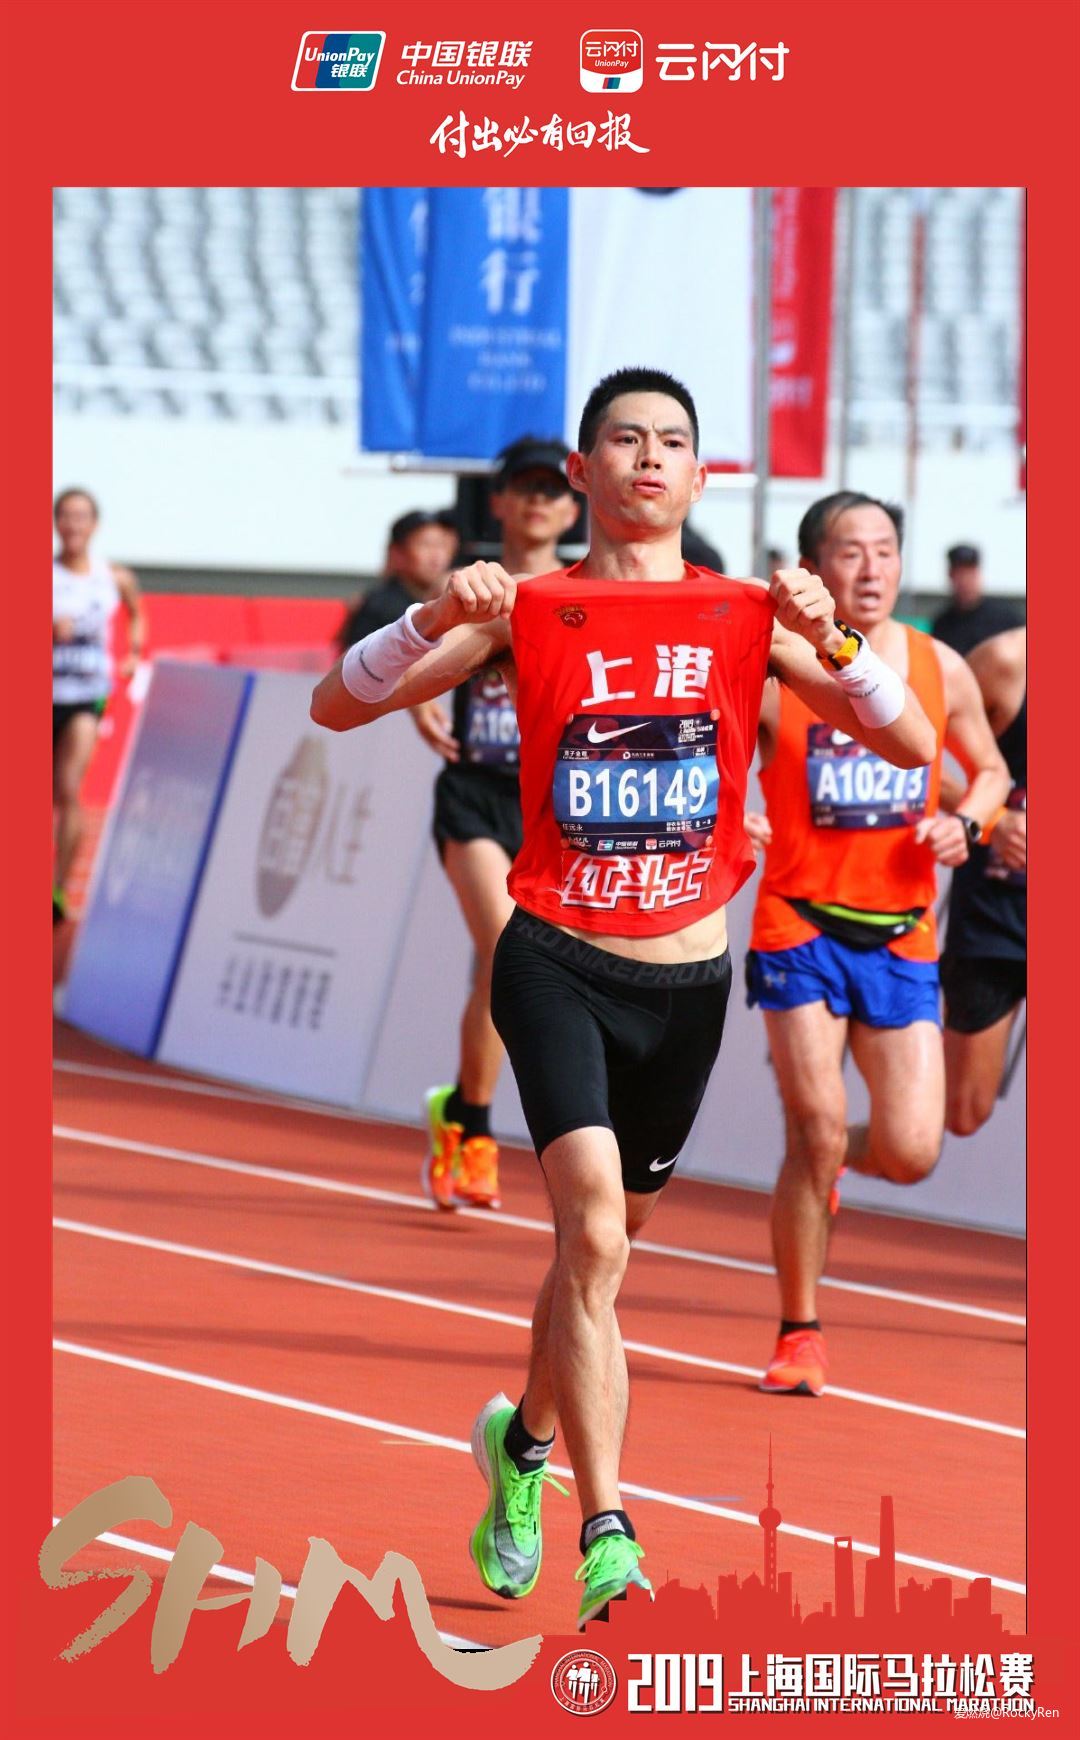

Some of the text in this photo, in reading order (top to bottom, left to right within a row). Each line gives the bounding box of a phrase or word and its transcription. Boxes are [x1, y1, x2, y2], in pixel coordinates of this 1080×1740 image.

[581, 644, 714, 707] 上港
[569, 766, 707, 817] B16149
[816, 761, 923, 802] A10273
[561, 854, 714, 910] 红斗士
[564, 942, 632, 979] NIKE
[631, 961, 698, 984] PRO
